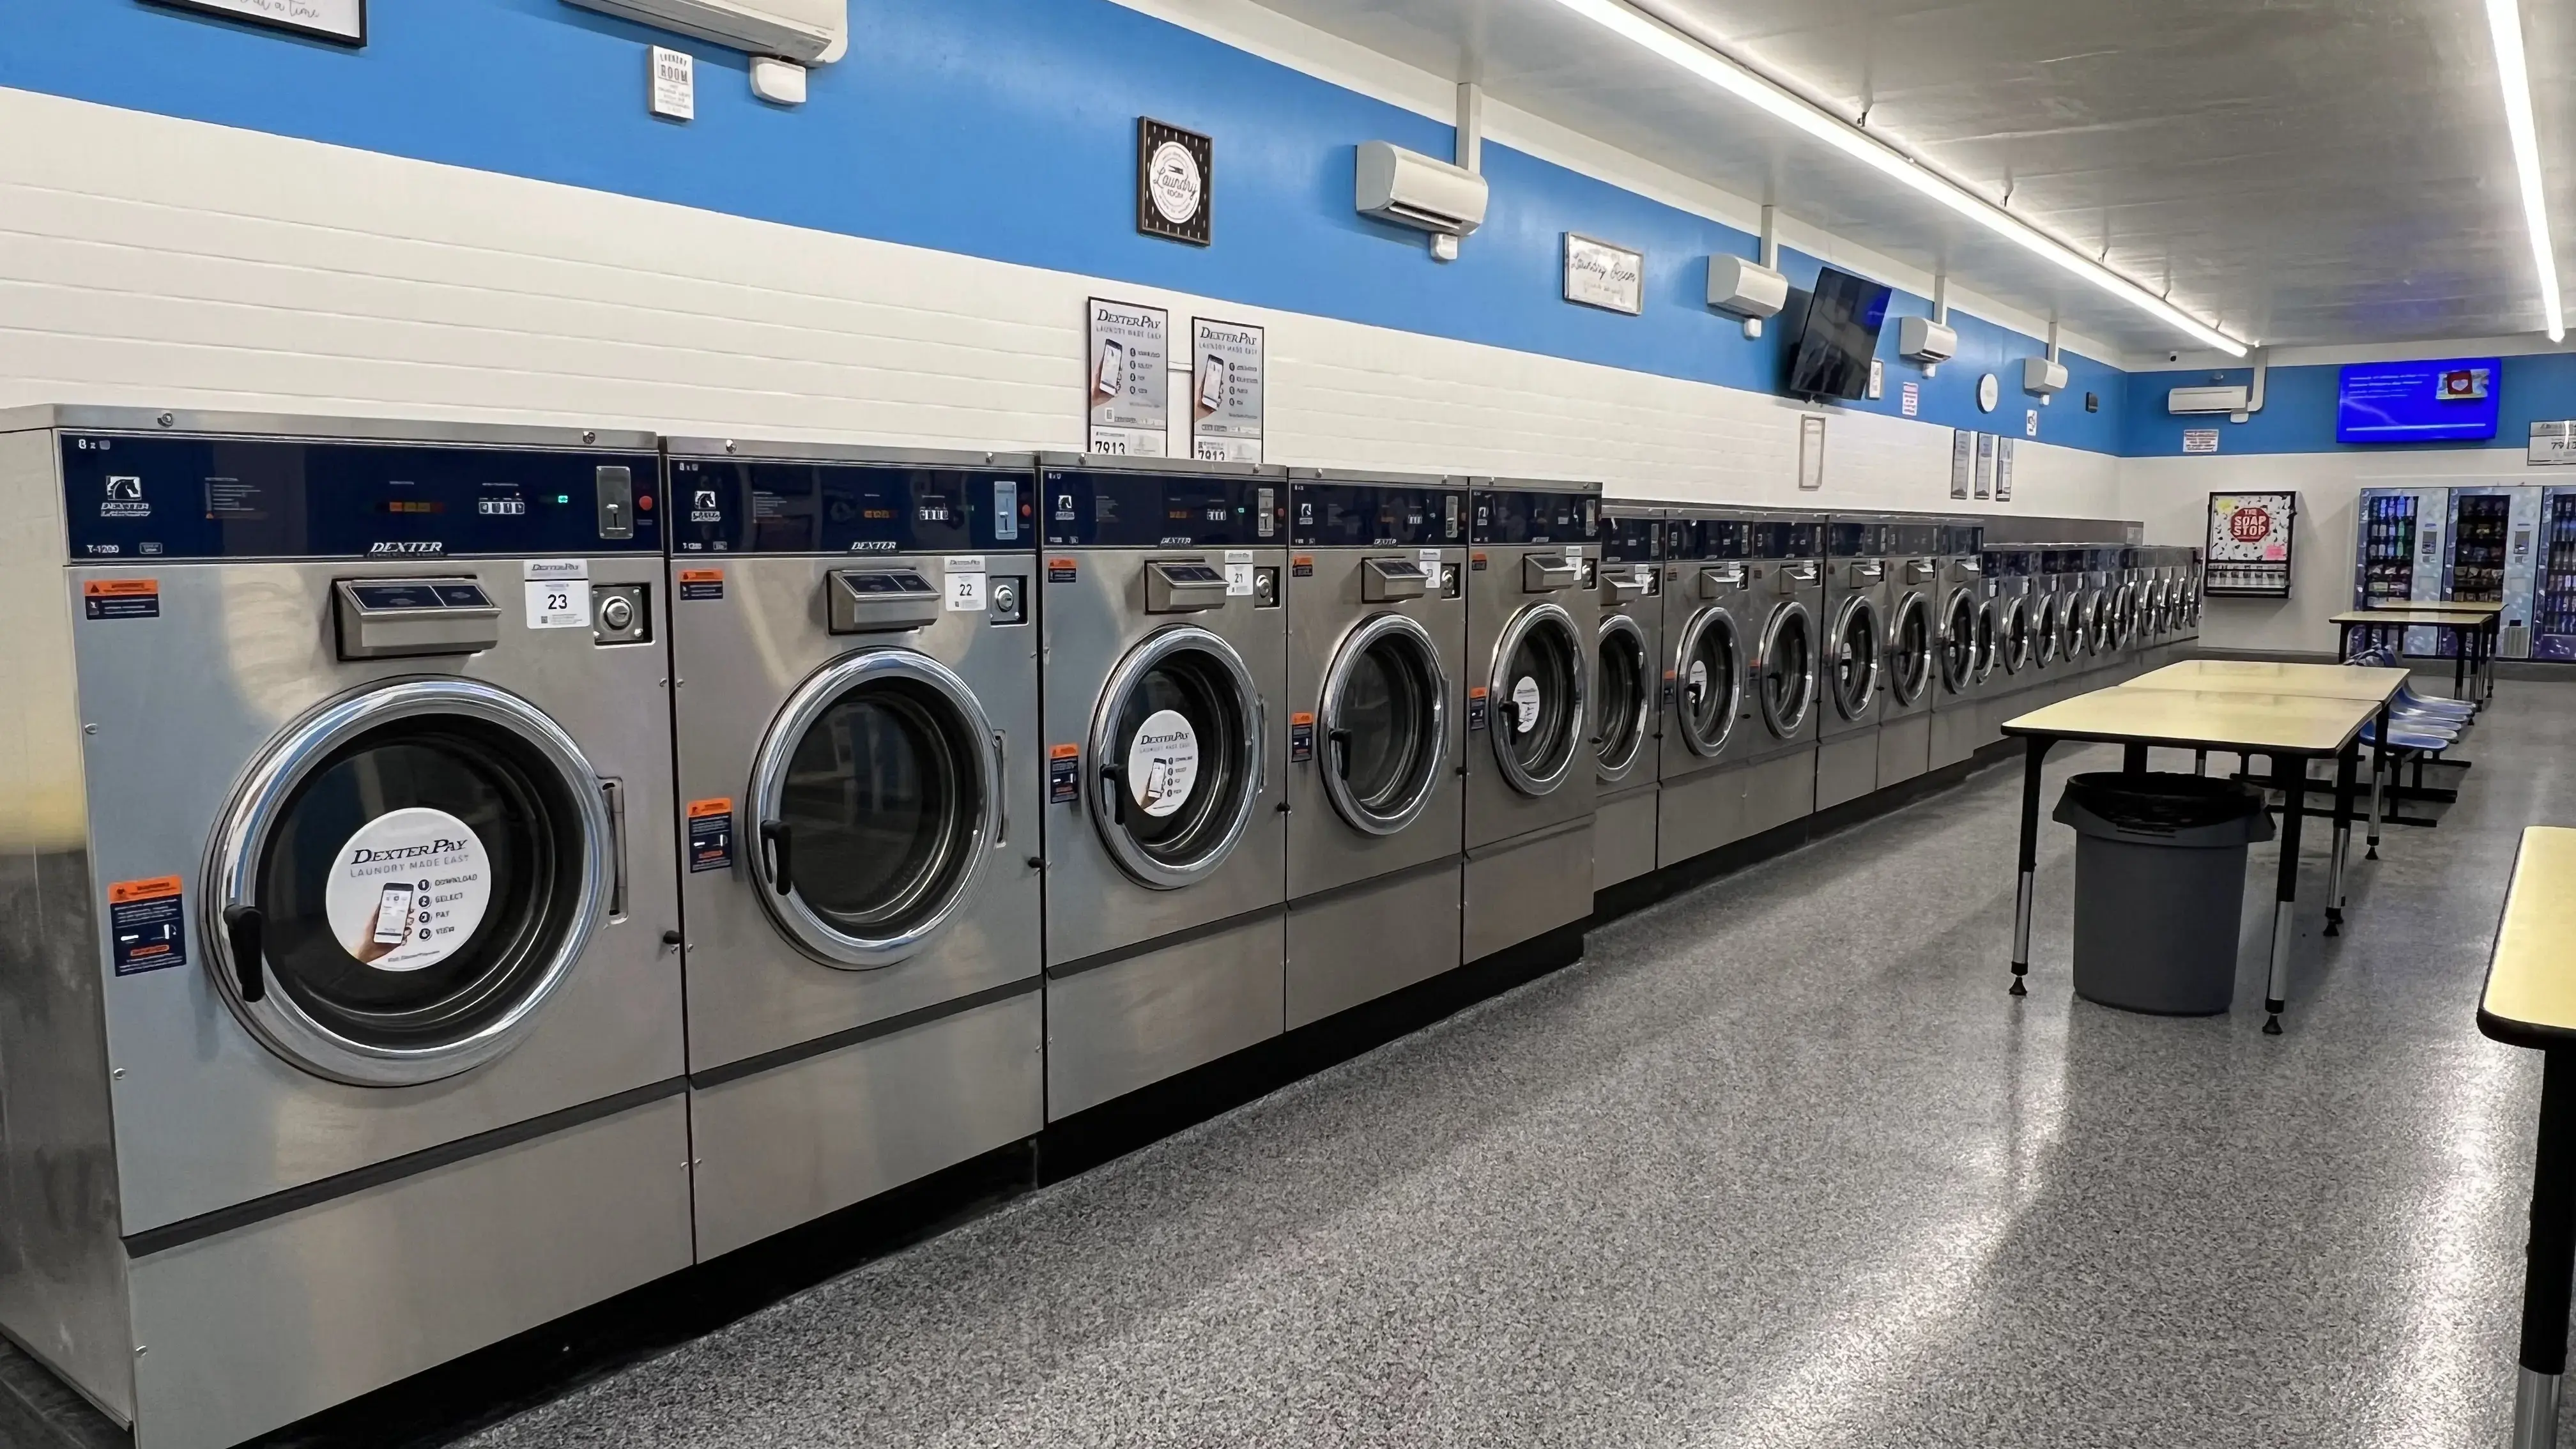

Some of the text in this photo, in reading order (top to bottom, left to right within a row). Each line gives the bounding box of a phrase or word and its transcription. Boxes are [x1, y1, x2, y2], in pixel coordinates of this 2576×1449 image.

[661, 65, 688, 82] ROOM
[2234, 515, 2267, 526] SOAP
[2233, 525, 2266, 536] STOP
[370, 542, 443, 552] DEXTER
[851, 542, 897, 550] DEXTER
[1235, 572, 1244, 583] 21
[959, 583, 972, 596] 22
[548, 594, 568, 610] 23
[351, 854, 469, 878] LAUNDRY MADE EASY
[434, 873, 478, 886] DOWNLOAD
[436, 910, 450, 919] PAY
